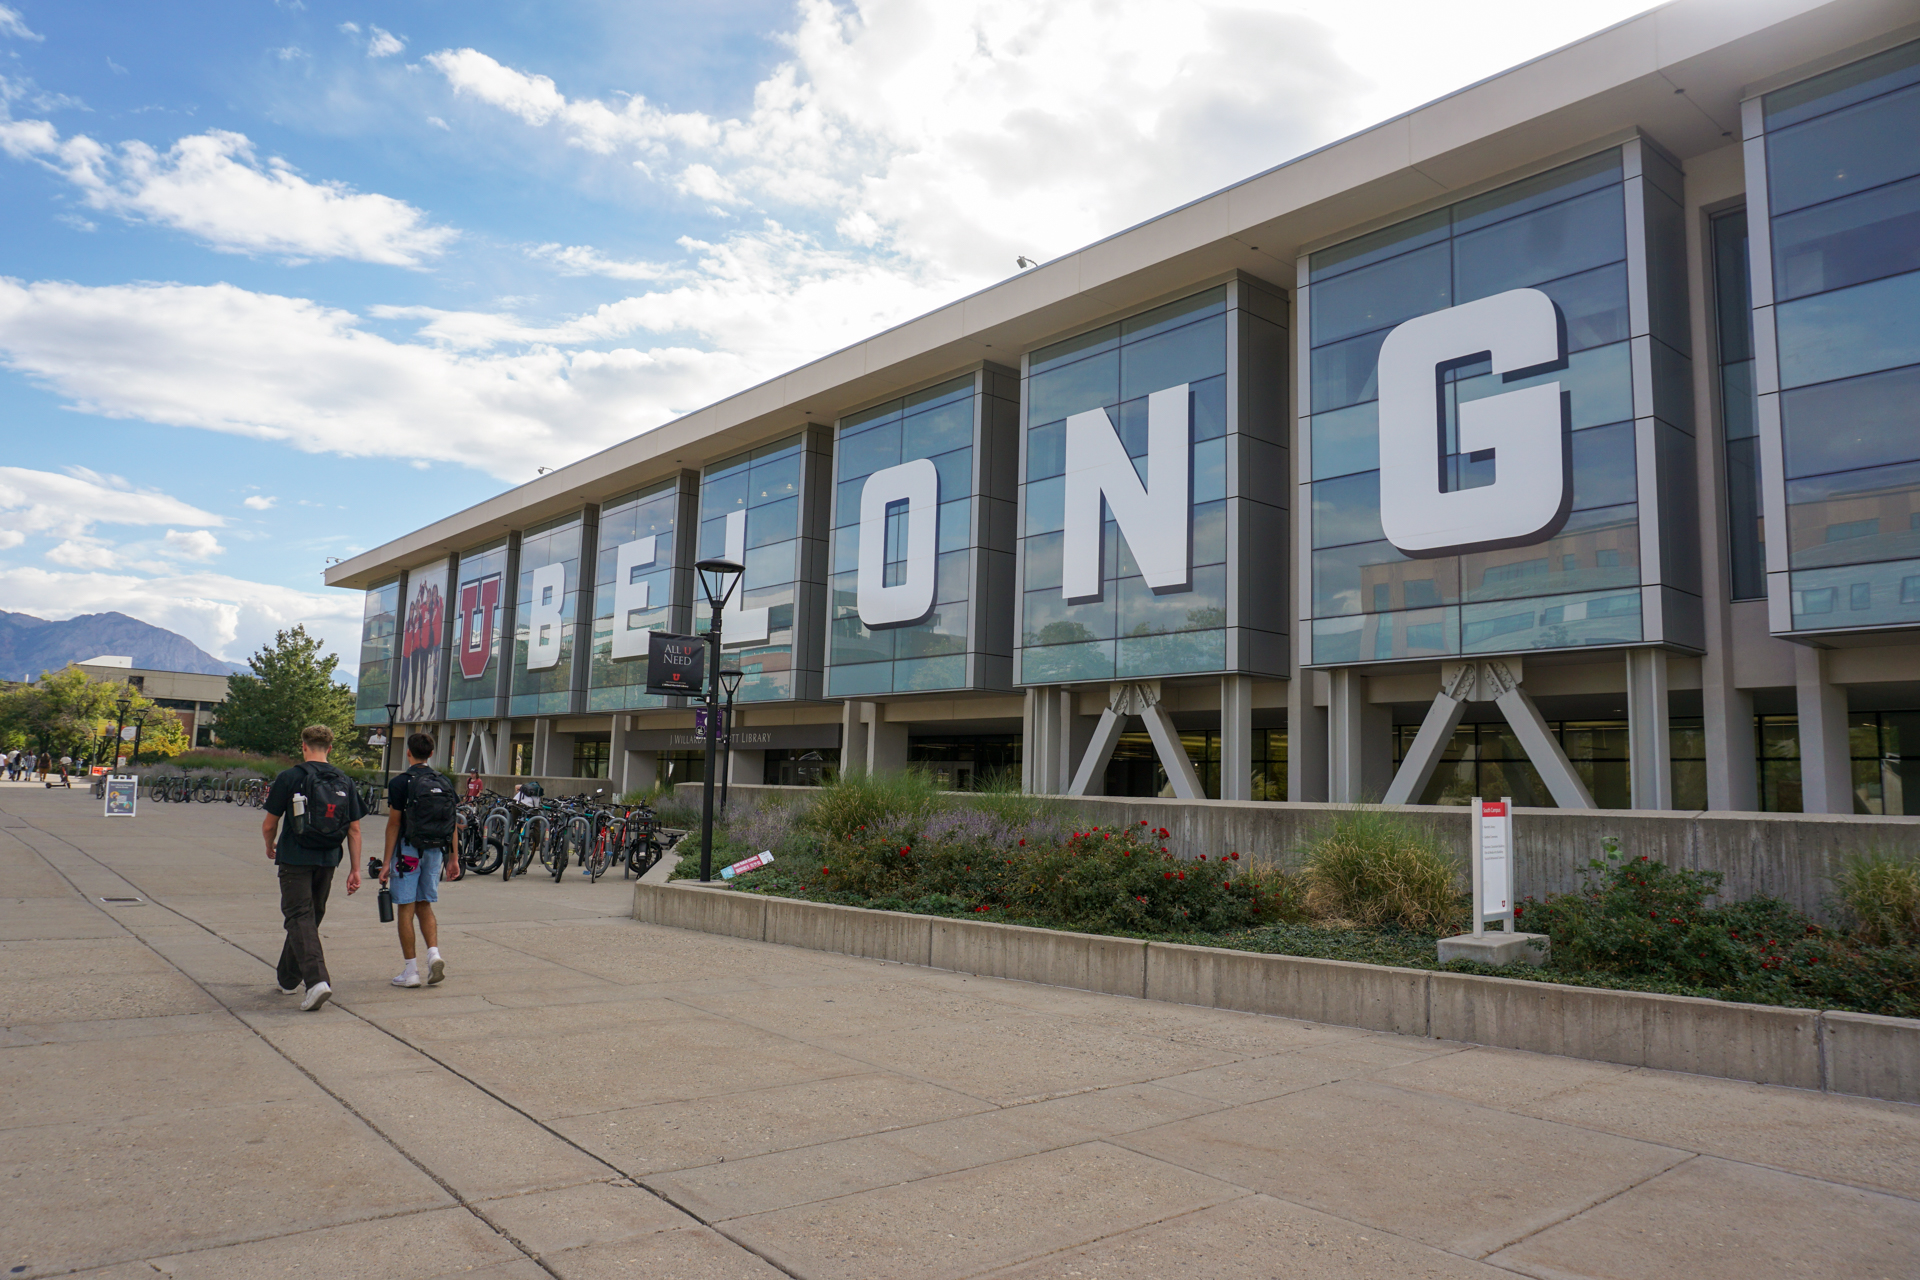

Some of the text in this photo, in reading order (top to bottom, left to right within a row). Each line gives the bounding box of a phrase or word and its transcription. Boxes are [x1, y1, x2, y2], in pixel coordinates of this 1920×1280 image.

[459, 288, 1567, 679] U BELONG
[664, 644, 691, 655] ALL U
[663, 654, 692, 666] NEED
[741, 732, 772, 743] LIBRARY
